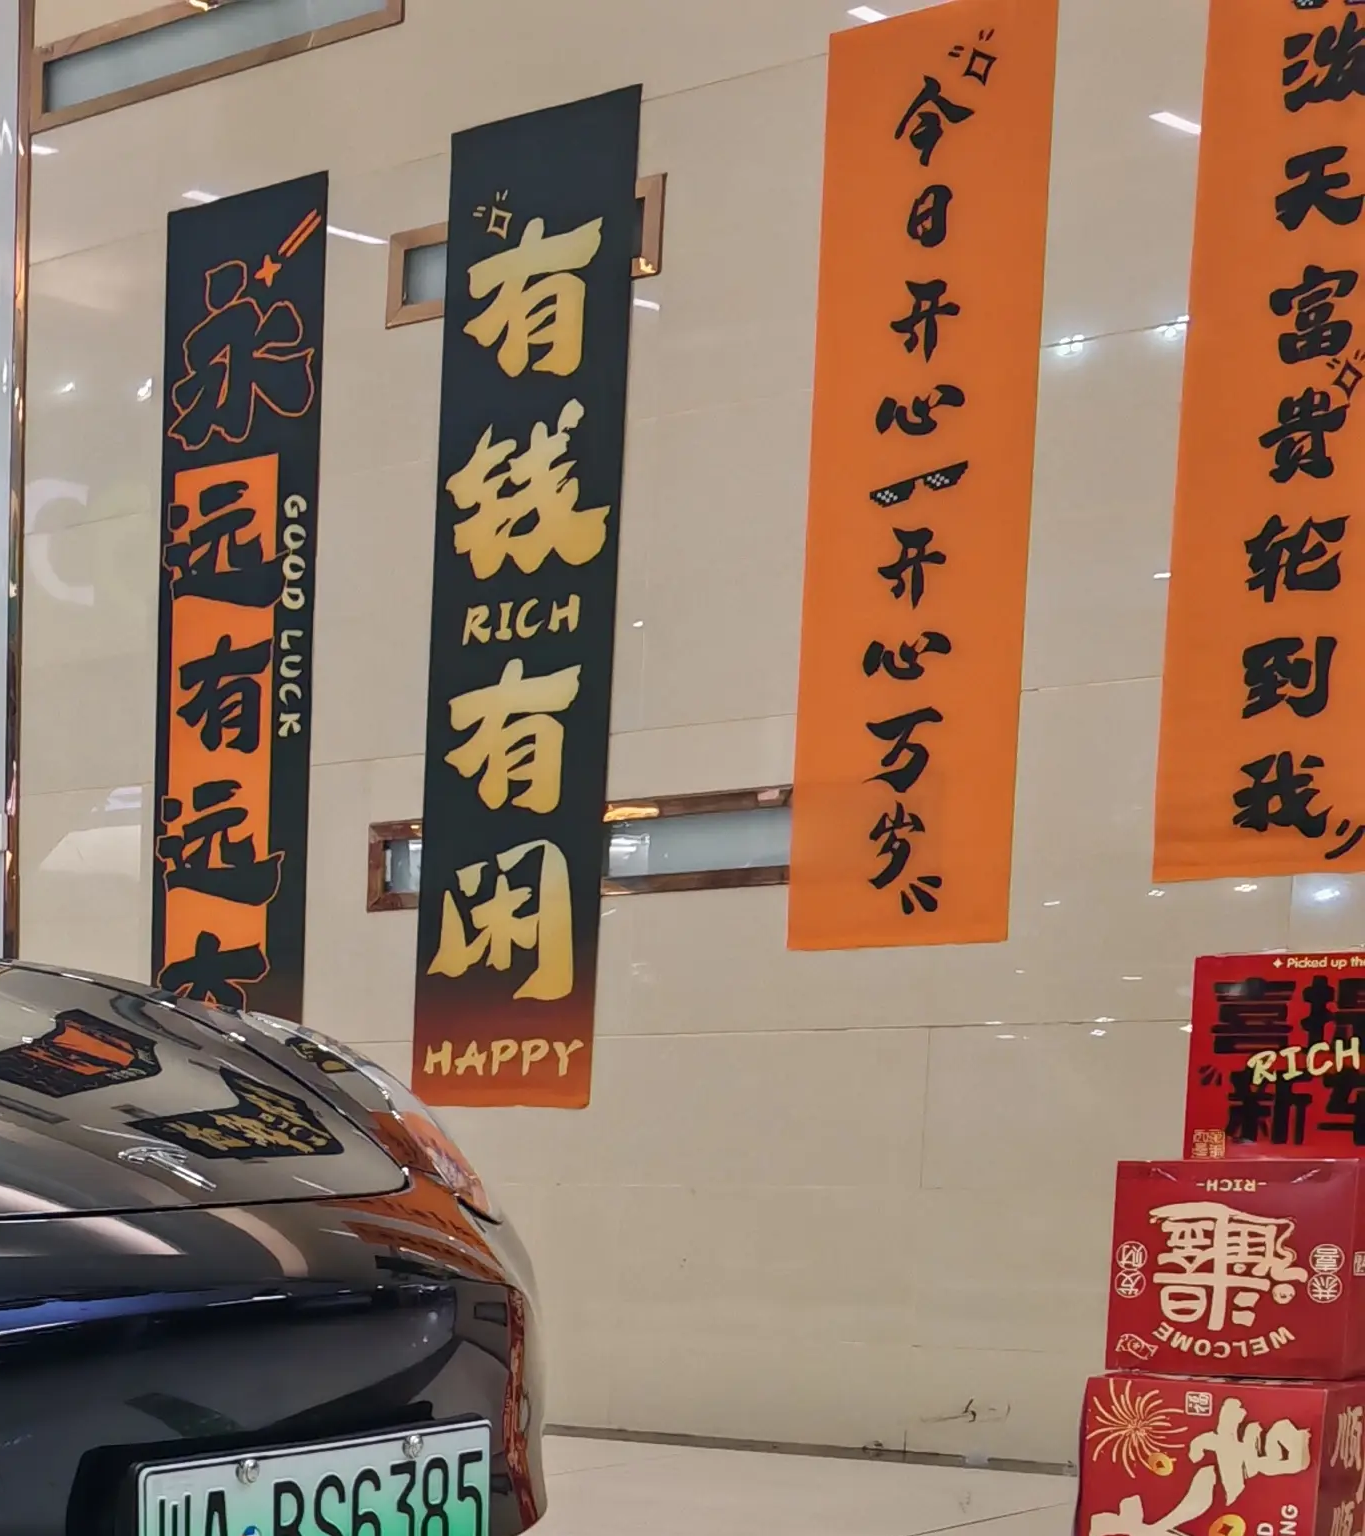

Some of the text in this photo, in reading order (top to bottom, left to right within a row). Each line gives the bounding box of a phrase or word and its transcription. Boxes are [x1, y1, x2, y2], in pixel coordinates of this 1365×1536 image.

[445, 216, 611, 580] 有钱
[277, 494, 307, 738] GOOD LUCK
[462, 593, 581, 646] RICH
[426, 657, 583, 1000] 有闲
[1286, 956, 1327, 969] Picked
[1330, 958, 1347, 970] up
[423, 1037, 585, 1078] HAPPY
[1247, 1037, 1360, 1085] RICH
[1152, 1322, 1295, 1359] WELCOME
